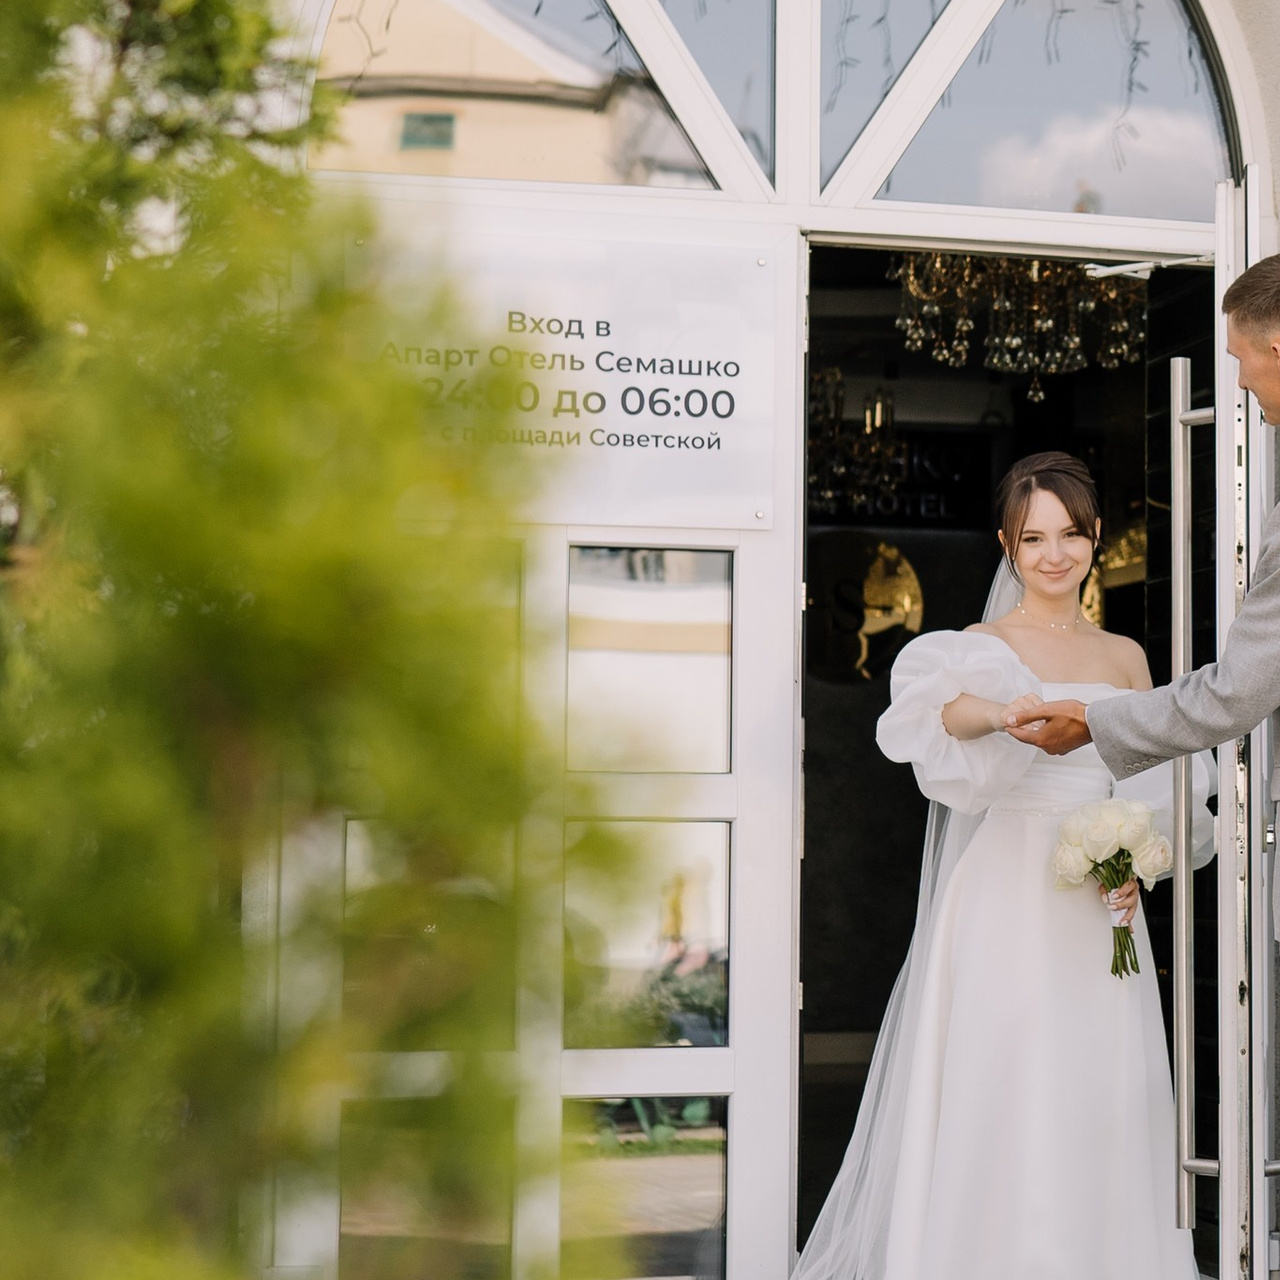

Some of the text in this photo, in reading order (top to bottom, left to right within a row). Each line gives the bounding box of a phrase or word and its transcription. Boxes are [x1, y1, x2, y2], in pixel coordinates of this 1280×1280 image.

[507, 311, 611, 339] Вход в
[379, 341, 741, 378] Апарт Отель Семашко
[553, 389, 607, 418] до
[620, 386, 736, 419] 06:00
[590, 428, 722, 450] Советской
